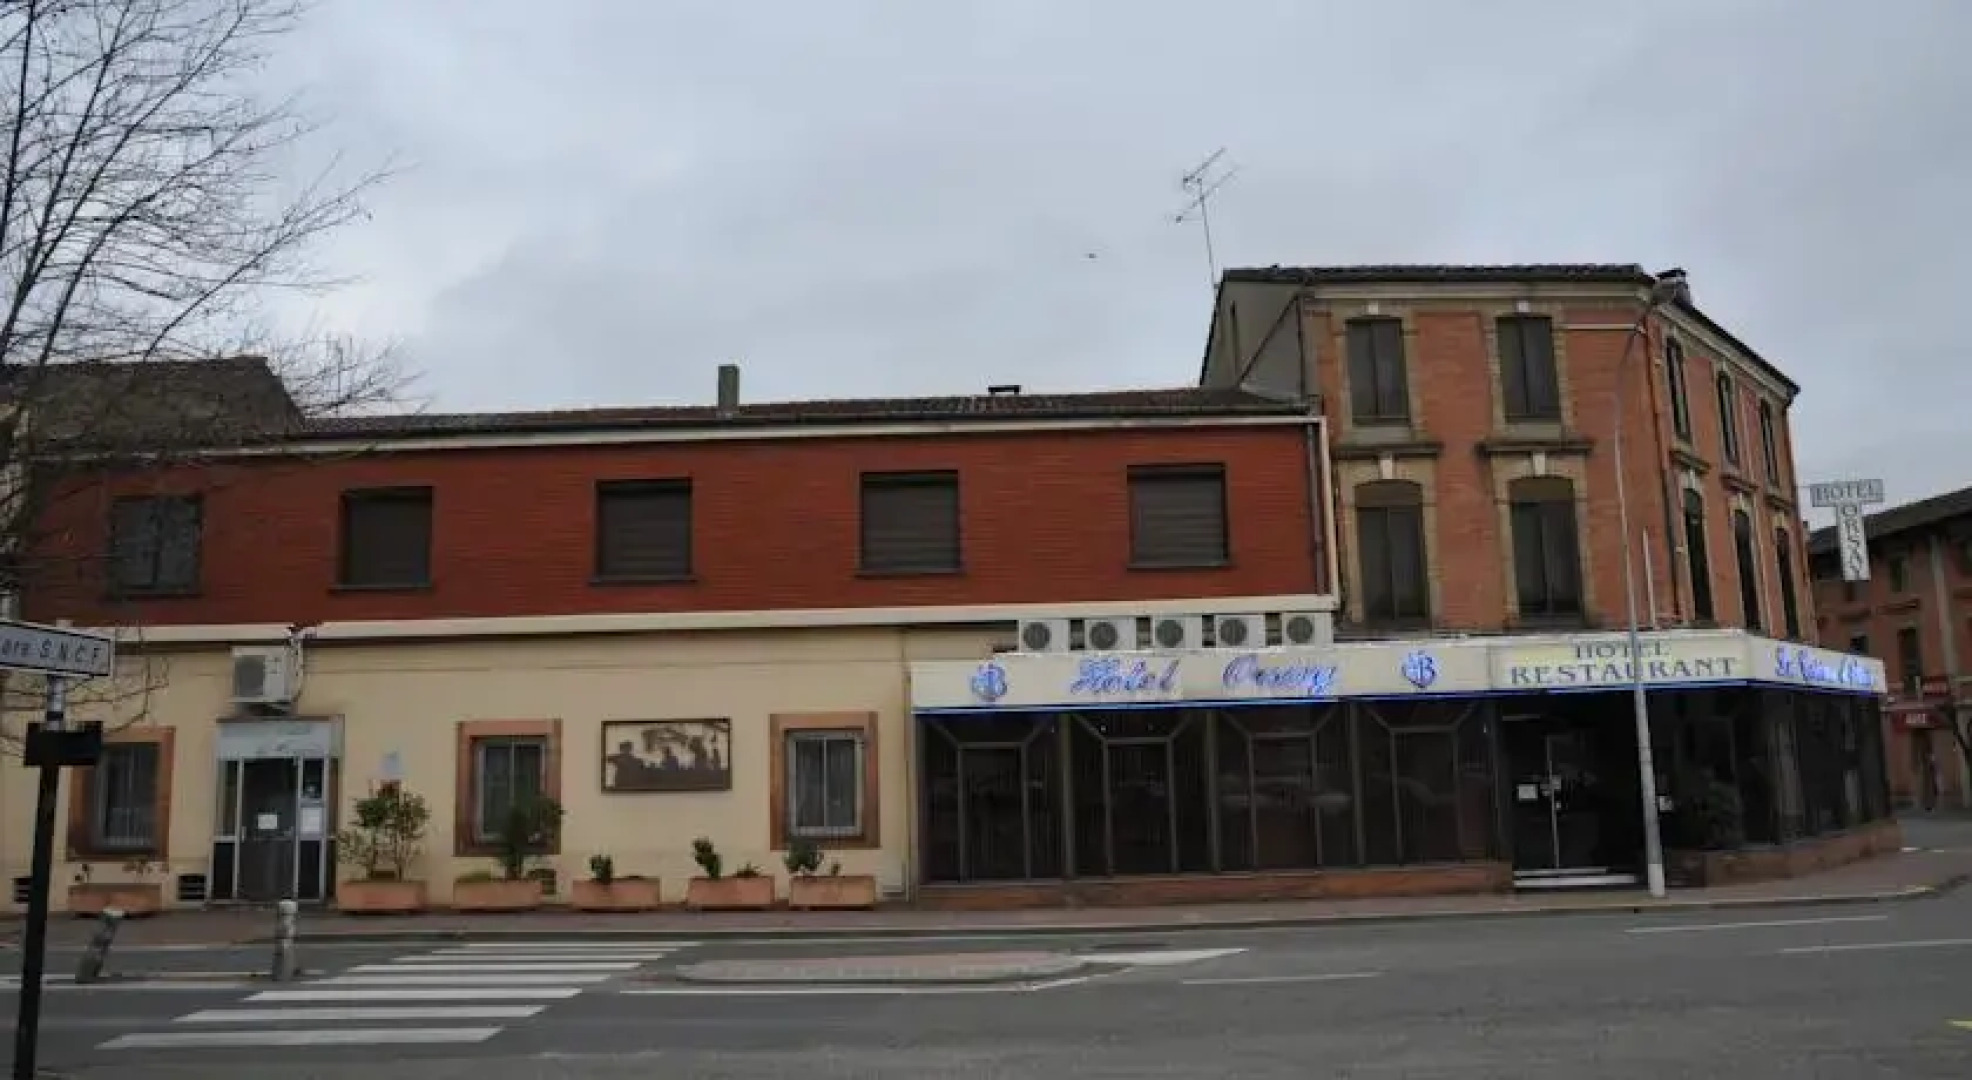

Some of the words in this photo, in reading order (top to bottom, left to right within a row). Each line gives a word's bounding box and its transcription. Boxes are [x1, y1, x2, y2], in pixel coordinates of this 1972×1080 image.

[1812, 481, 1882, 502] HOTEL
[1576, 639, 1670, 659] HOTEL
[1511, 657, 1737, 685] RESTAURANT
